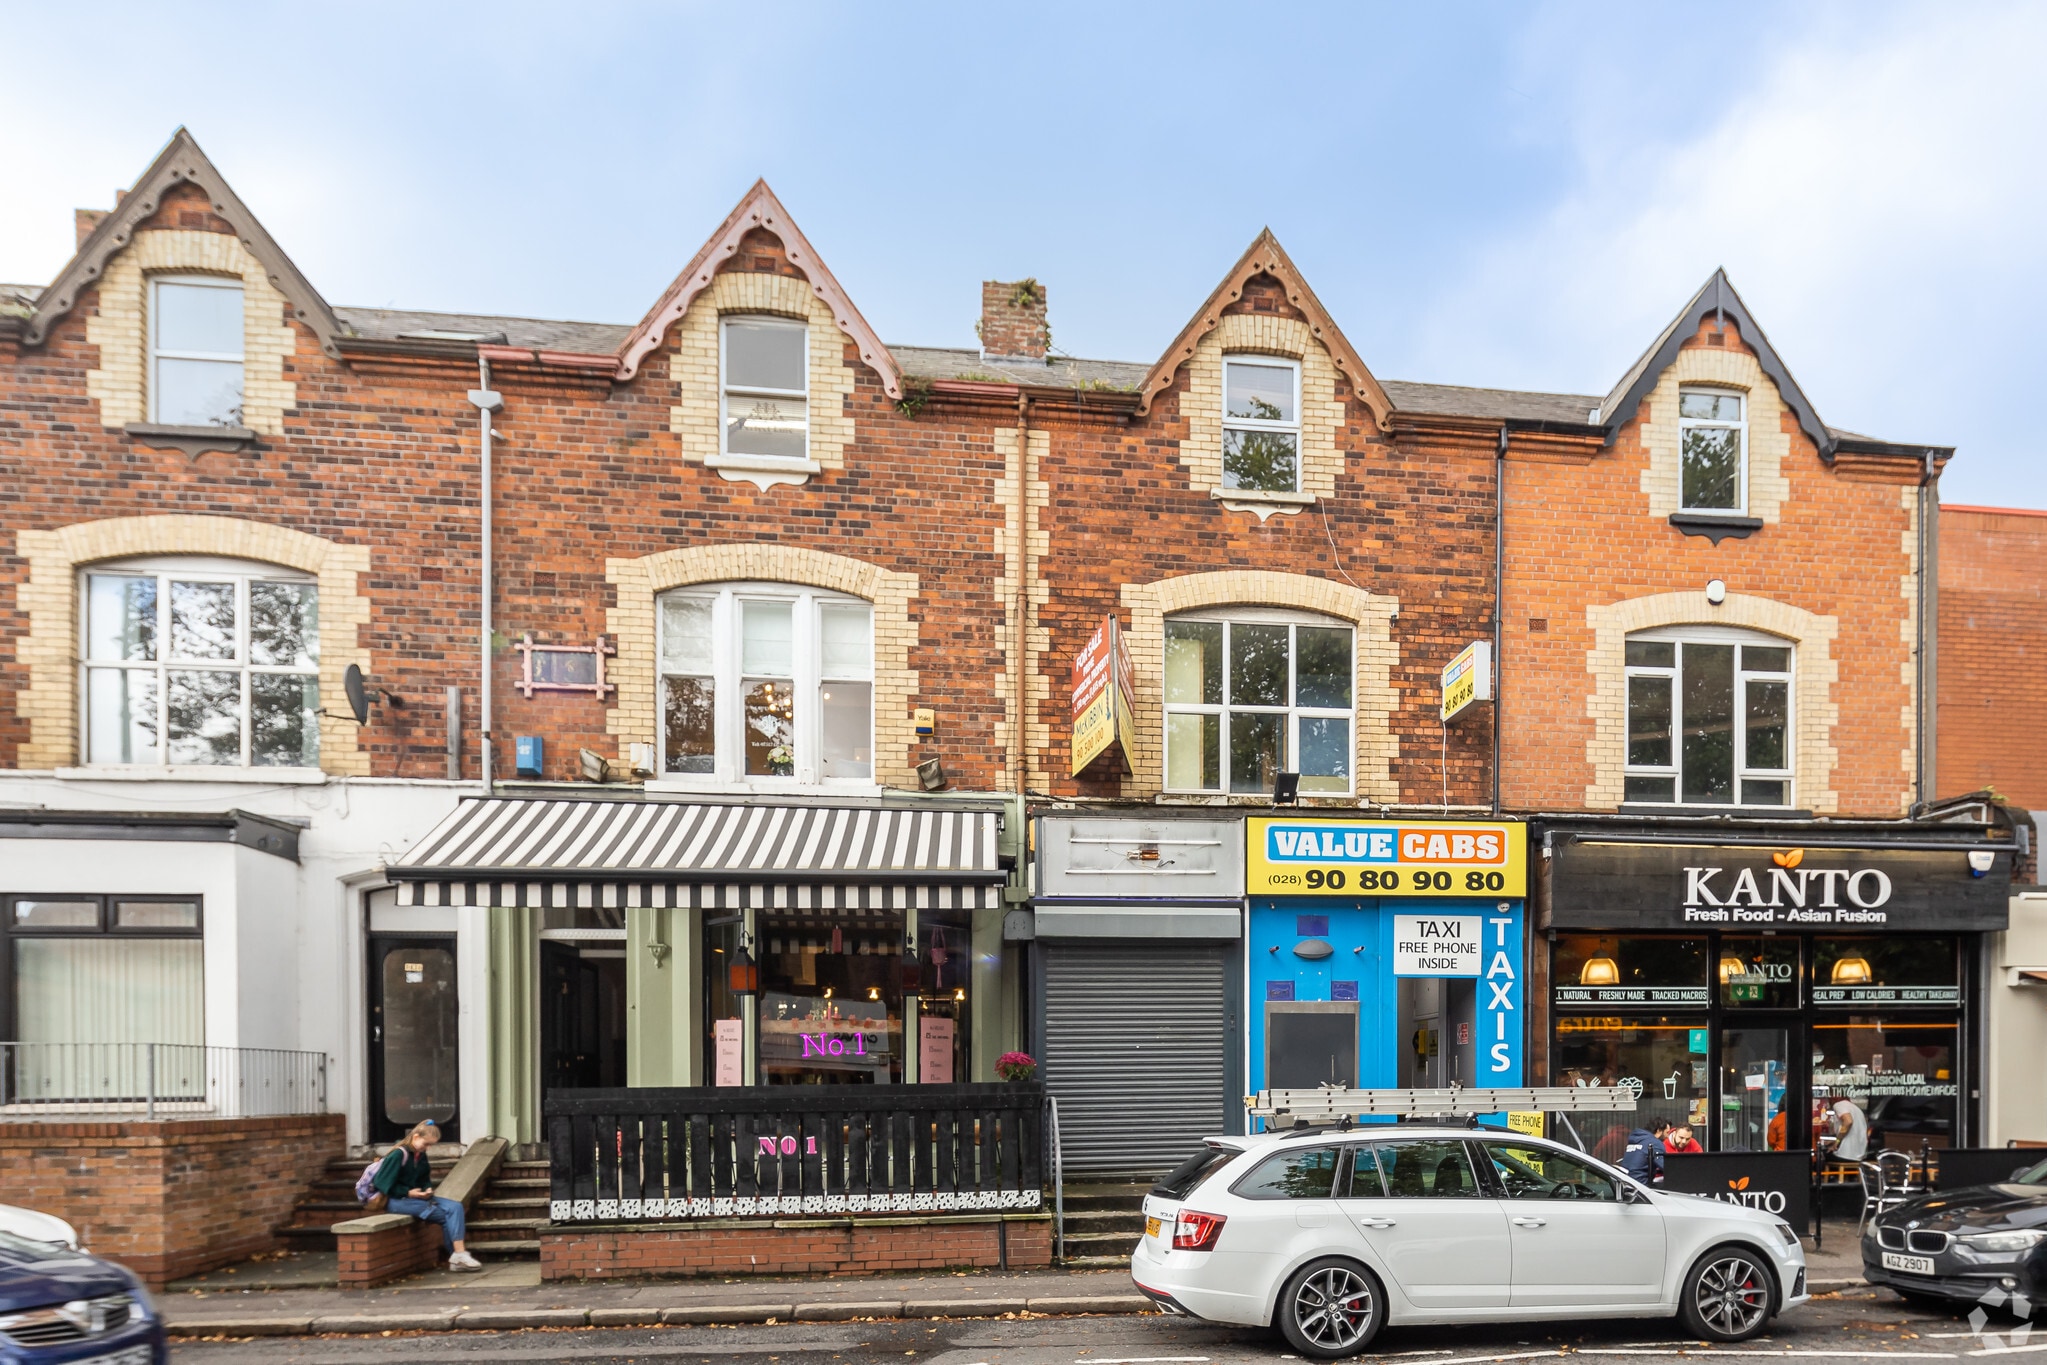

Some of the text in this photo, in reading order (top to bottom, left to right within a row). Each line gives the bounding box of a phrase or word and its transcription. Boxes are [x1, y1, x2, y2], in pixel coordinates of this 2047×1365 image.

[1076, 627, 1102, 672] FOR SALE
[917, 714, 931, 722] Yale
[1077, 746, 1083, 760] 90
[1274, 831, 1499, 859] VALUE CABS
[1268, 870, 1505, 891] (028) 90 80 90 80
[1683, 867, 1892, 908] KANTO
[1685, 908, 1729, 921] Fresh
[1733, 908, 1774, 922] Food
[1787, 909, 1831, 922] Asian
[1835, 909, 1886, 923] Fusion
[1416, 921, 1461, 938] TAXI
[1399, 942, 1477, 954] FREE PHONE
[1418, 958, 1457, 969] INSIDE
[1486, 918, 1515, 1072] TAXIS
[1563, 991, 1592, 1000] NATURAL
[1599, 991, 1645, 1000] FRESHLY MADE
[1652, 991, 1707, 1000] TRACKED MACROS
[1829, 991, 1845, 1000] PREP
[1852, 991, 1895, 1000] LOW CALORIES
[1902, 990, 1926, 1000] HEALTHY
[800, 1032, 867, 1058] No.1
[1866, 1075, 1902, 1086] FUSION
[1903, 1074, 1926, 1085] LOCAL
[1509, 1114, 1542, 1128] FREE PHONE
[759, 1136, 817, 1155] NO 1
[1886, 1256, 1929, 1271] AGZ 2907
